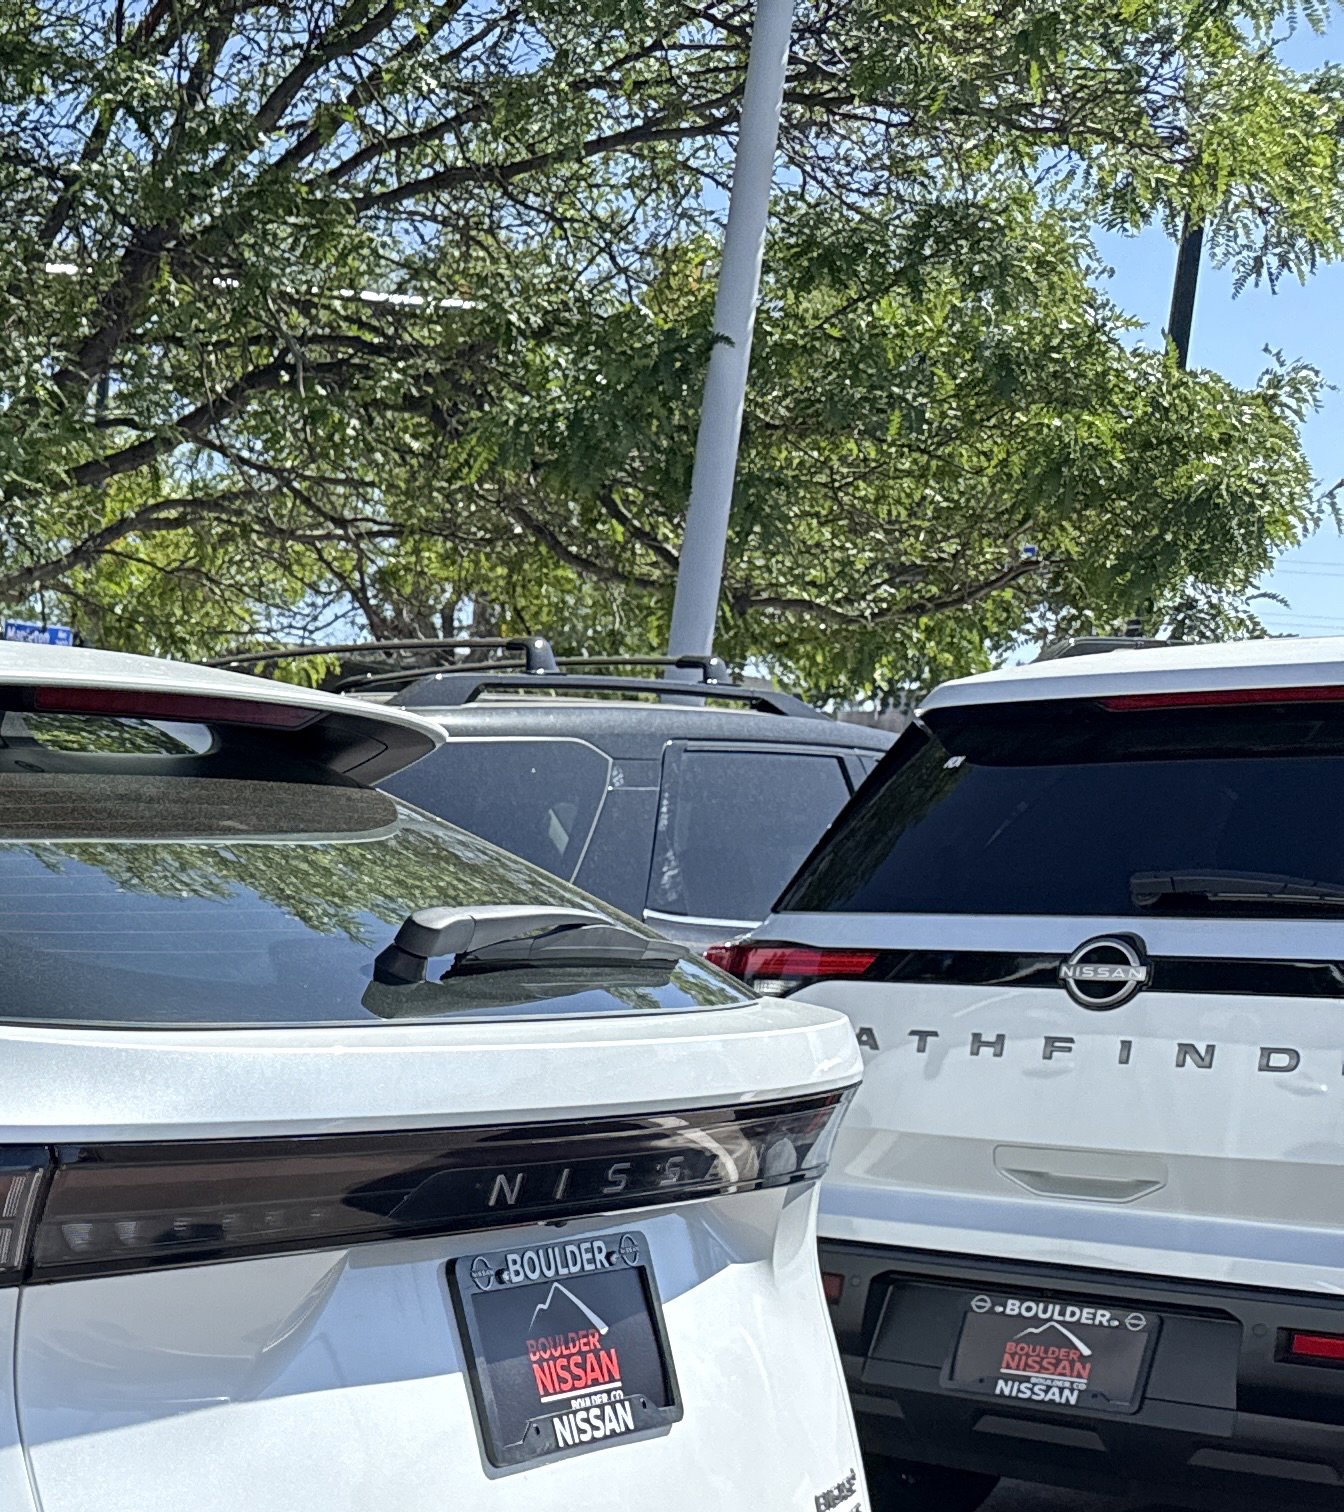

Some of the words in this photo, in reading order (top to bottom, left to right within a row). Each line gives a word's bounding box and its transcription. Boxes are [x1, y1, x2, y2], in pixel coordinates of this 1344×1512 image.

[1059, 964, 1144, 979] NISSAN
[855, 1026, 1344, 1076] ATHFIND
[505, 1239, 610, 1284] BOULDER
[1004, 1298, 1112, 1327] BOULDER
[526, 1328, 602, 1361] BOULDER
[1004, 1341, 1082, 1362] BOULDER
[532, 1348, 621, 1395] NISSAN
[1000, 1352, 1092, 1379] NISSAN
[994, 1379, 1080, 1406] NISSAN
[552, 1400, 635, 1448] NISSAN
